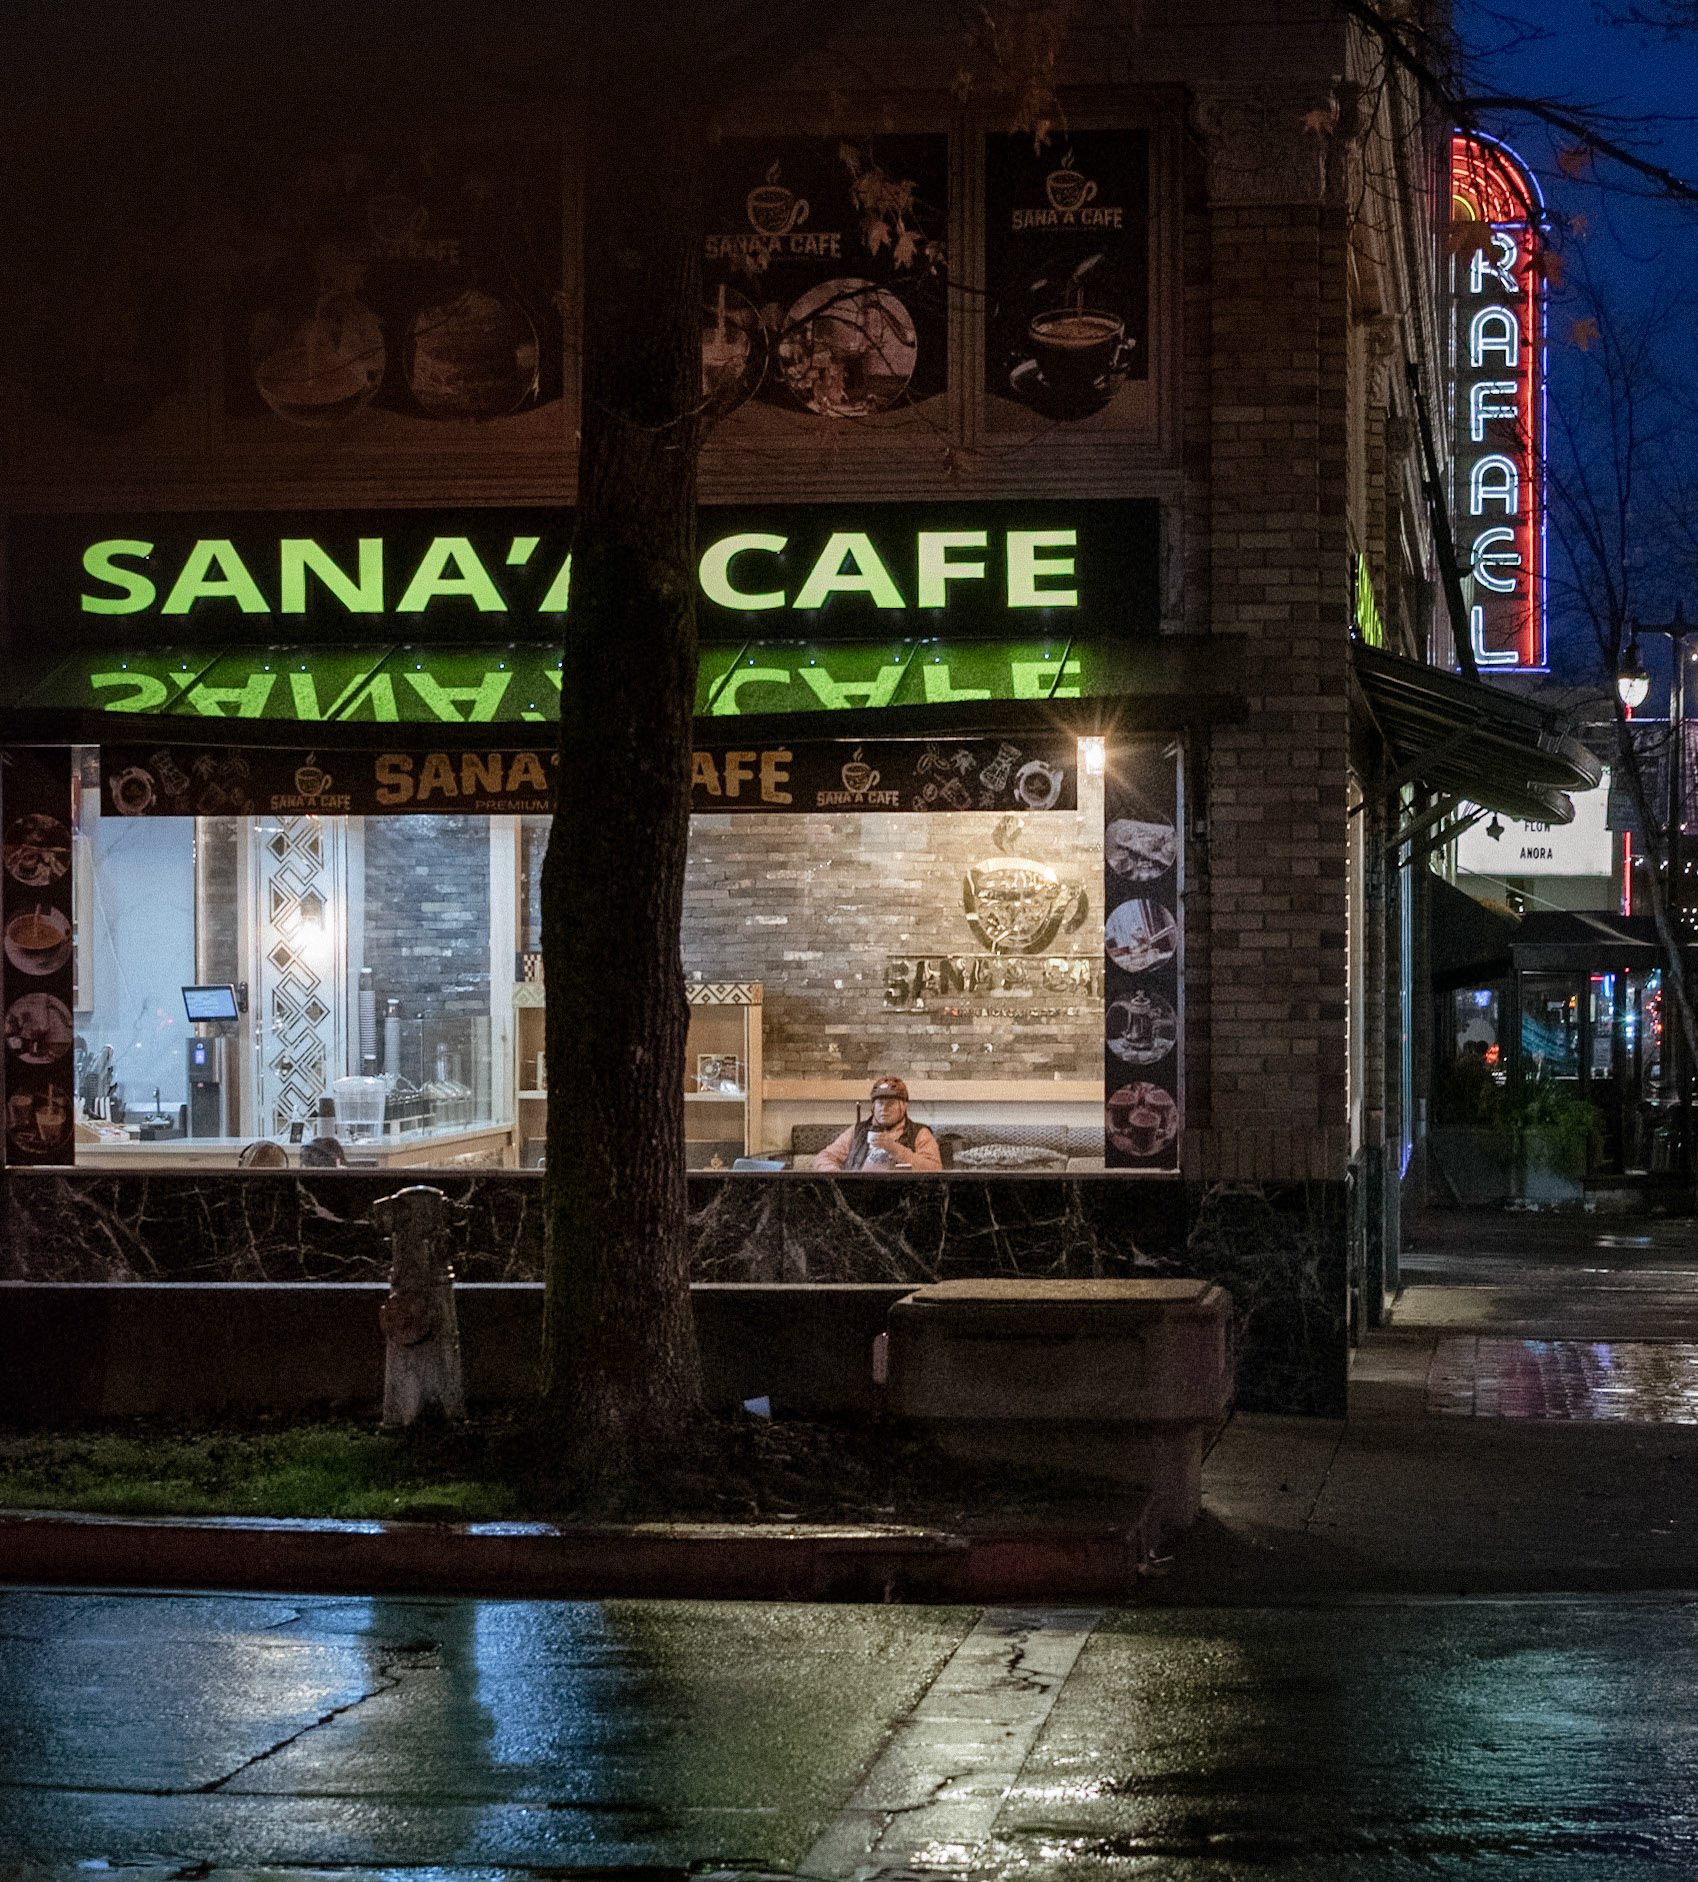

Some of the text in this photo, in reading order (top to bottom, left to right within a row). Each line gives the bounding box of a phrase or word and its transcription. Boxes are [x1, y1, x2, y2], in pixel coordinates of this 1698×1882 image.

[1081, 208, 1123, 229] CAFE
[789, 234, 842, 259] CAFE
[1470, 232, 1521, 665] RAFAEL
[81, 530, 1079, 615] SANA' CAFE
[374, 746, 794, 806] SANA' AFÉ
[320, 794, 352, 811] CAFE
[475, 799, 549, 811] PREMIUM
[867, 790, 900, 807] CAFE
[1519, 846, 1553, 860] ANORA
